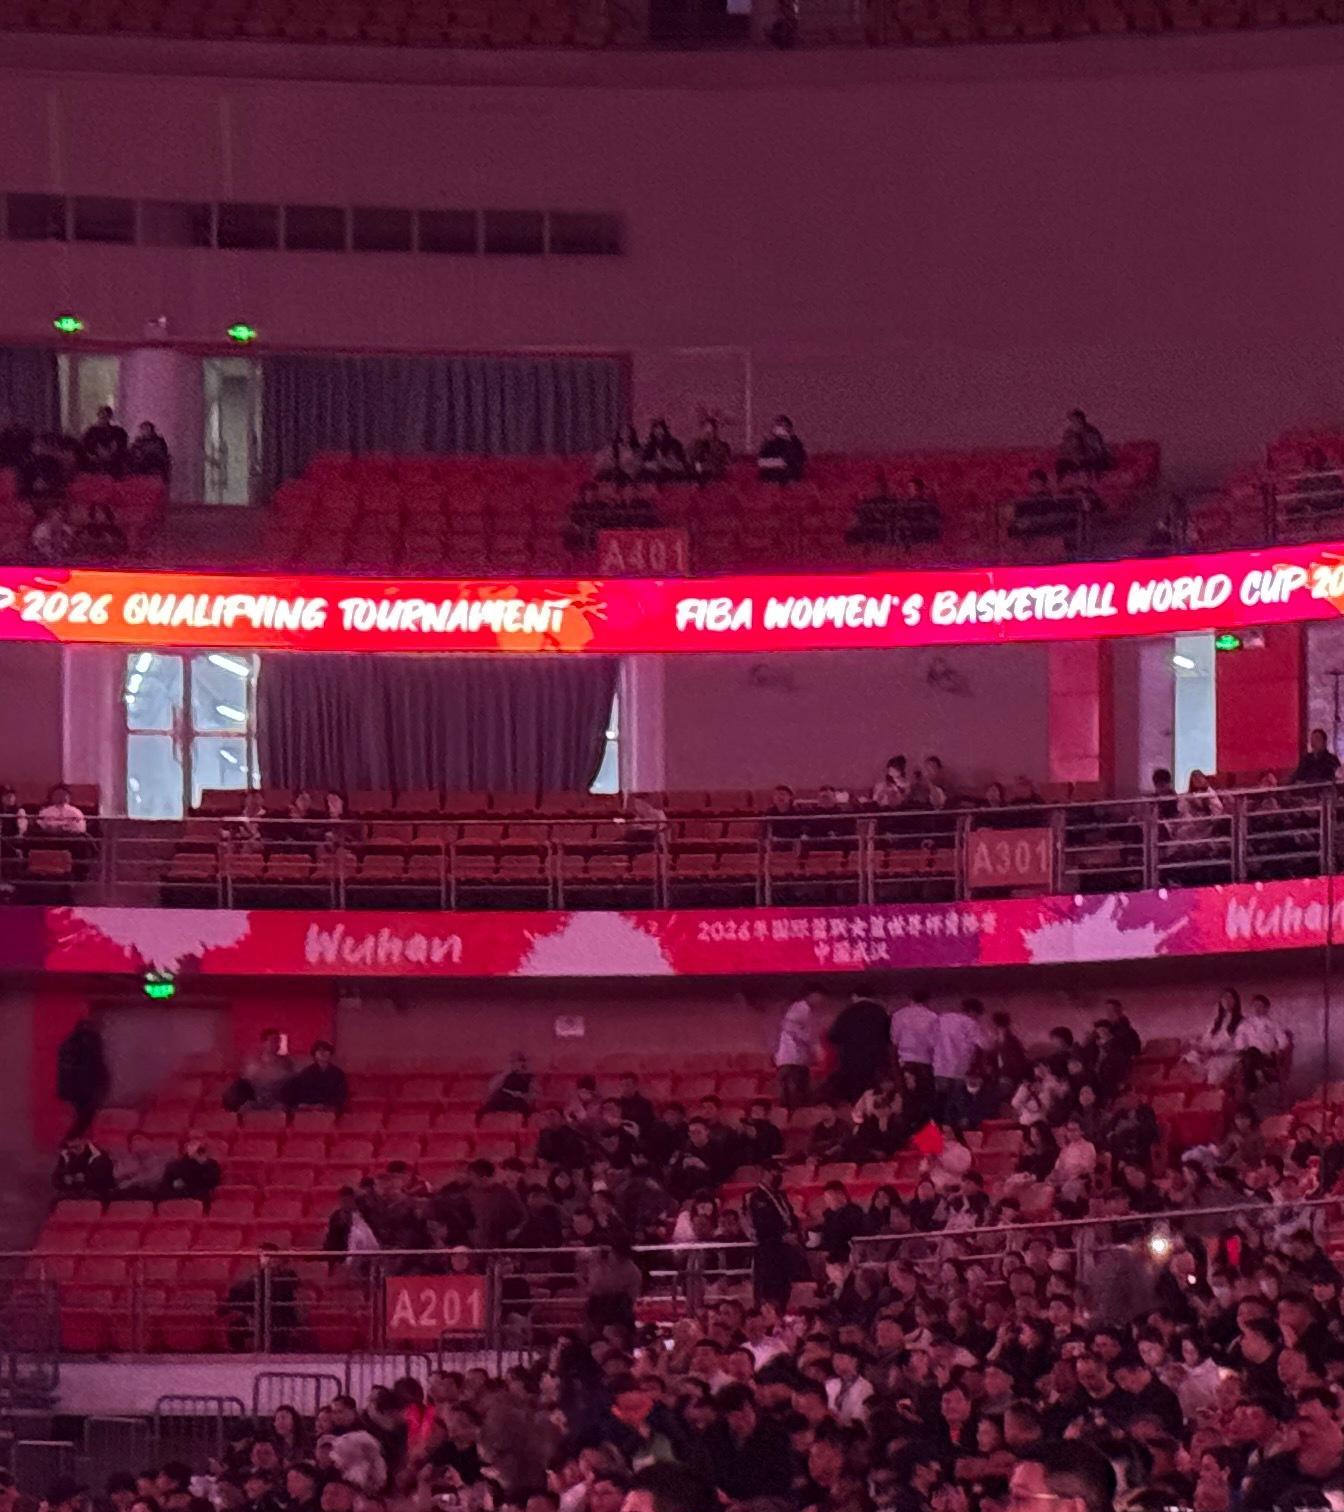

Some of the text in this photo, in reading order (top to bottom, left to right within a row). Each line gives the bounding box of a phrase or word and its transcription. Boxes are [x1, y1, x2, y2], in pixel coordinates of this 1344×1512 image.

[20, 589, 113, 624] 2026
[123, 592, 330, 630] QUALIFYING
[337, 598, 569, 635] TOURNAMENT
[675, 597, 753, 632] FIBA
[763, 594, 921, 630] WOMEN'S
[931, 583, 1118, 626] BASKETBALL
[1127, 572, 1233, 614] WORLD
[1239, 568, 1312, 604] CUP
[973, 839, 1047, 875] A301
[304, 922, 463, 965] Wuhan
[391, 1288, 482, 1328] A201
